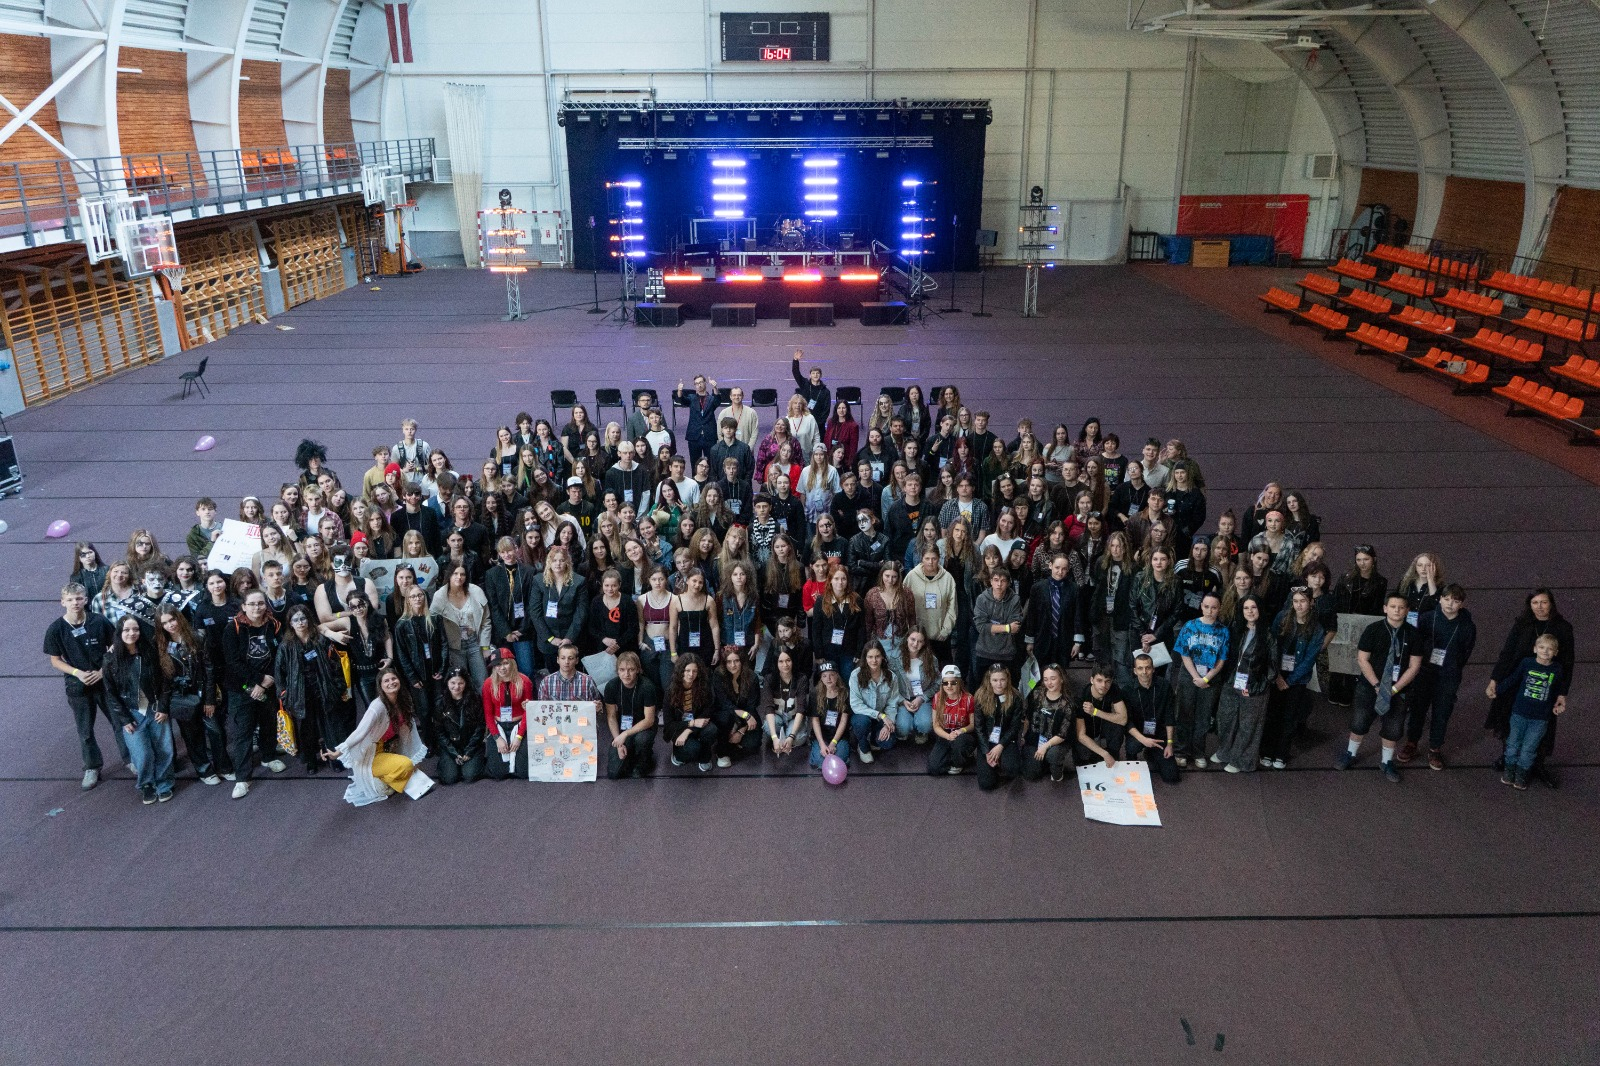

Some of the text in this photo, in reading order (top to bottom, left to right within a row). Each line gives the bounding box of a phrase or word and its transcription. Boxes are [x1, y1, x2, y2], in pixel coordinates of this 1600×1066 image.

[763, 48, 790, 60] 16:04
[580, 516, 591, 527] 10
[1084, 782, 1107, 792] 16
